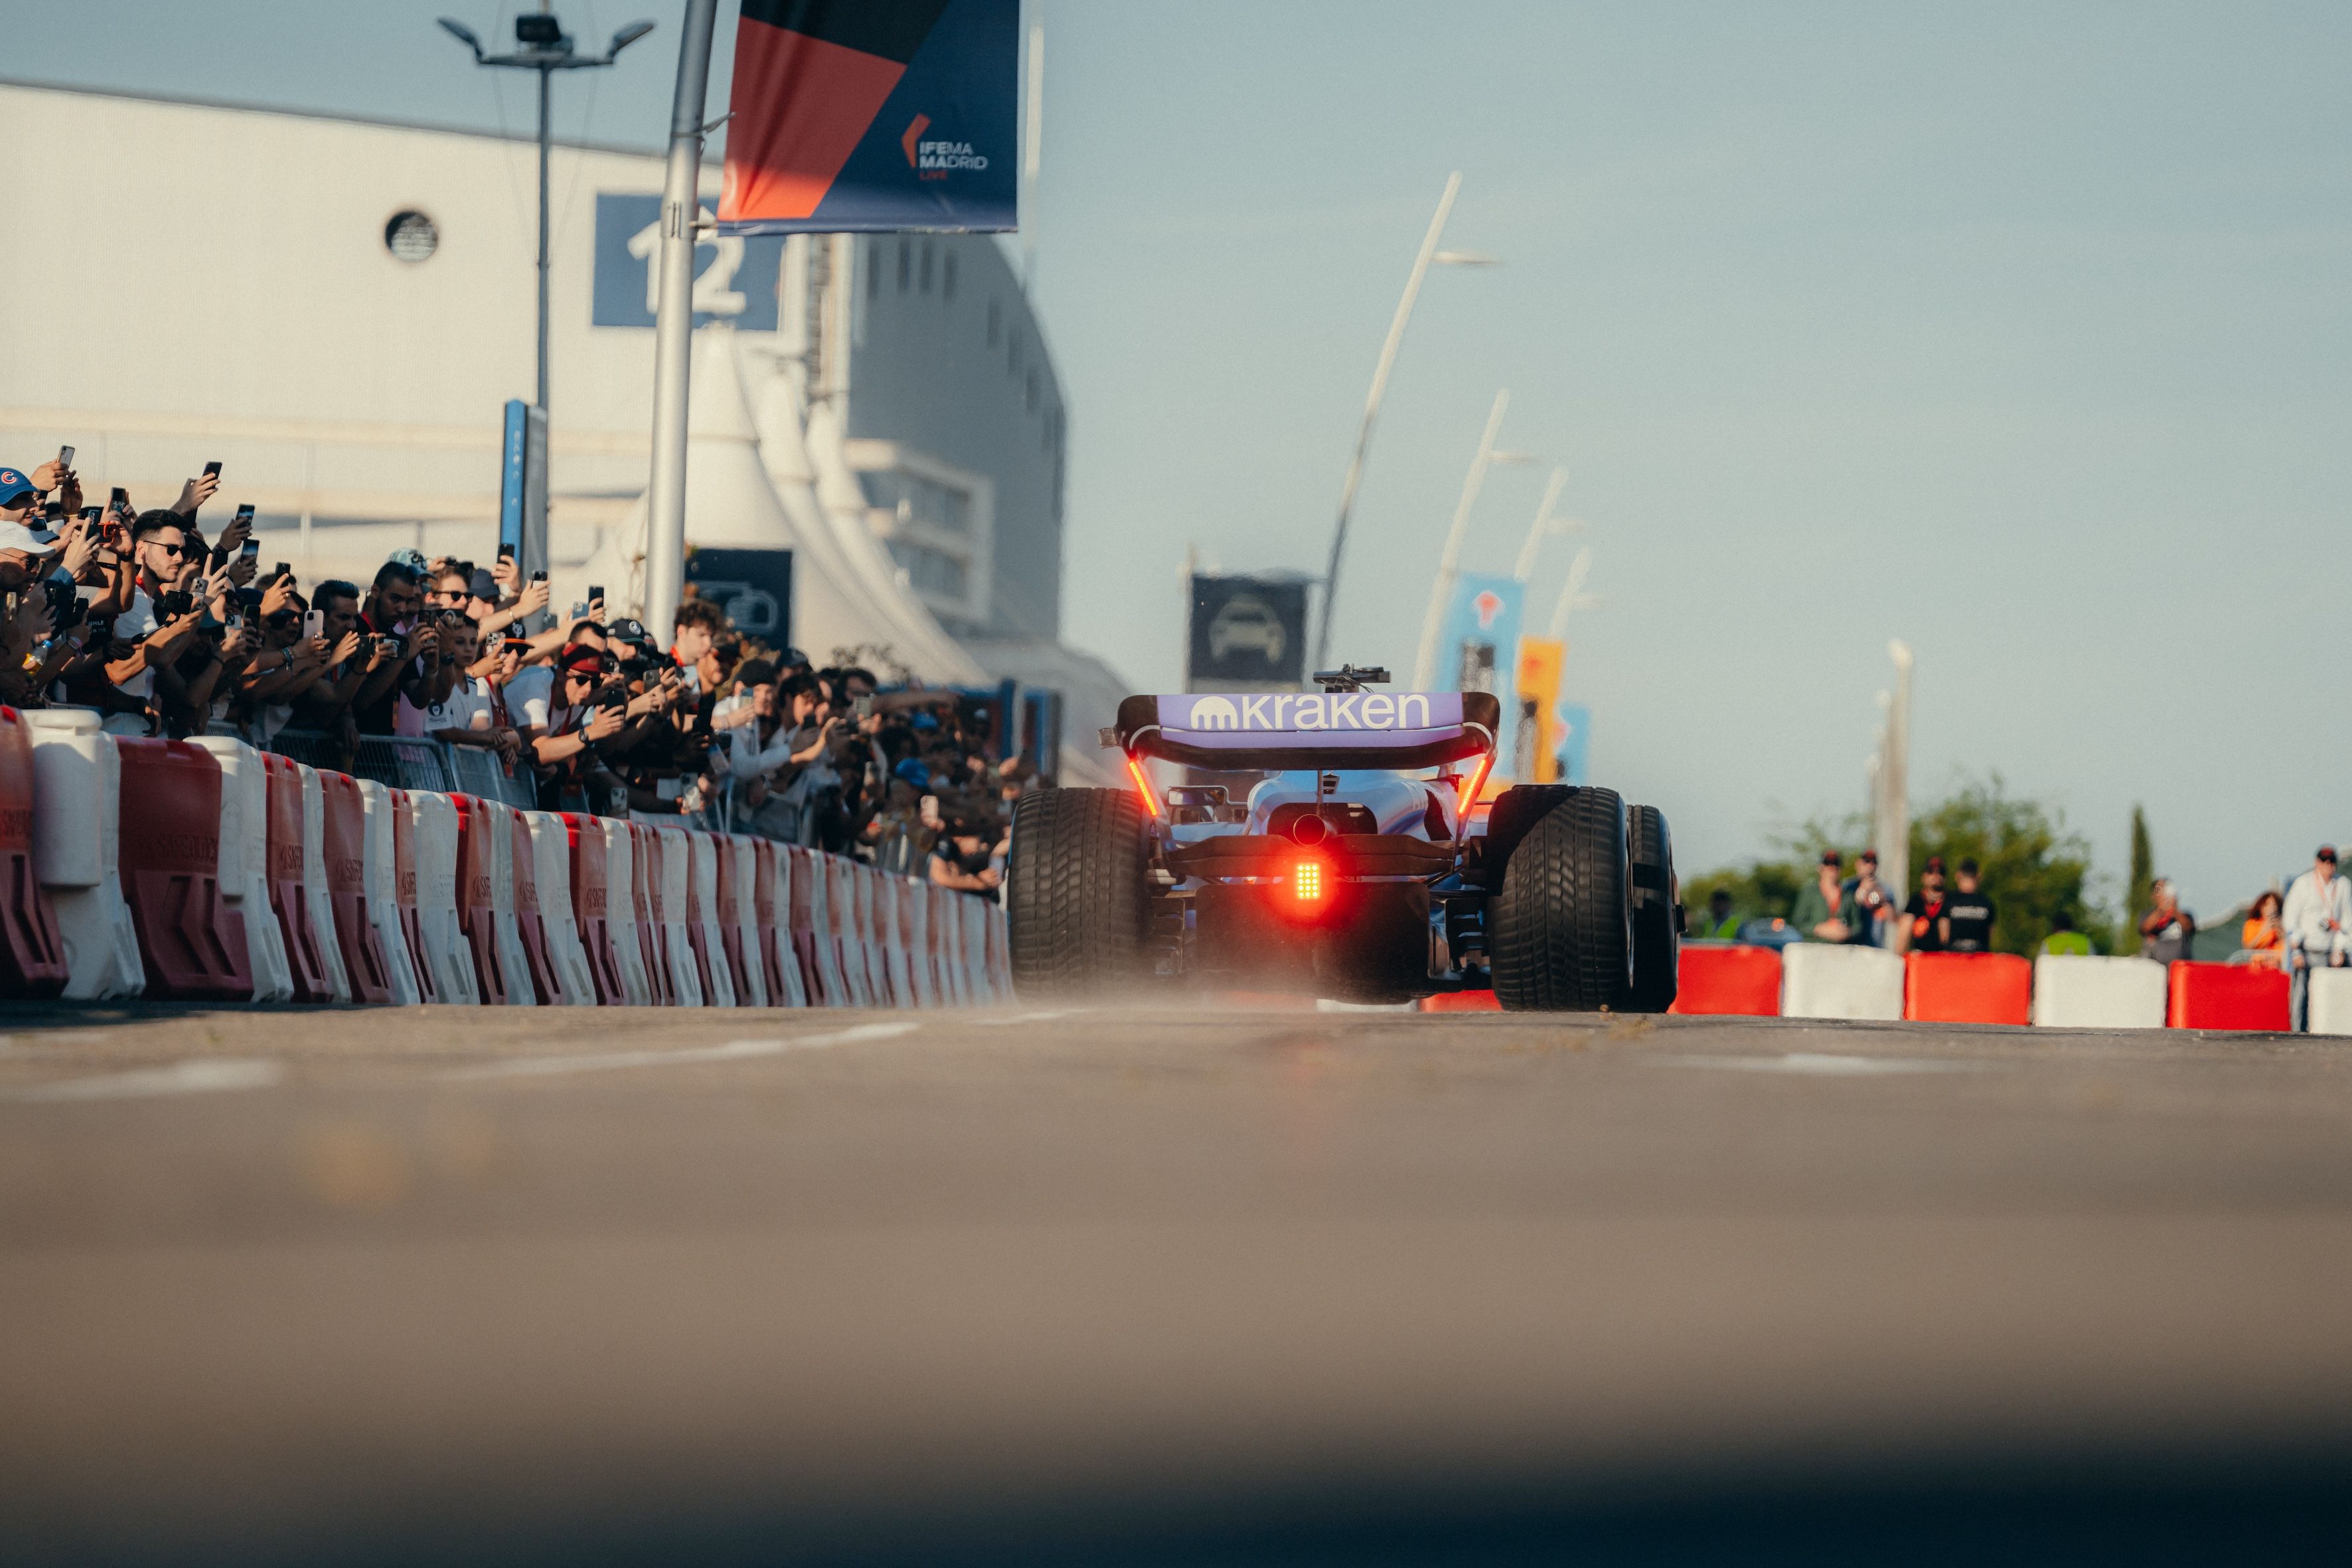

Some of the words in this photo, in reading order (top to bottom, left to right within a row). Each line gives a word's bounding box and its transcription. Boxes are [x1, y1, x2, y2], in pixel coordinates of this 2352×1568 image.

[919, 141, 974, 155] IFEMA
[919, 155, 988, 169] MADRID
[627, 205, 746, 314] 12
[1241, 694, 1430, 730] kraken
